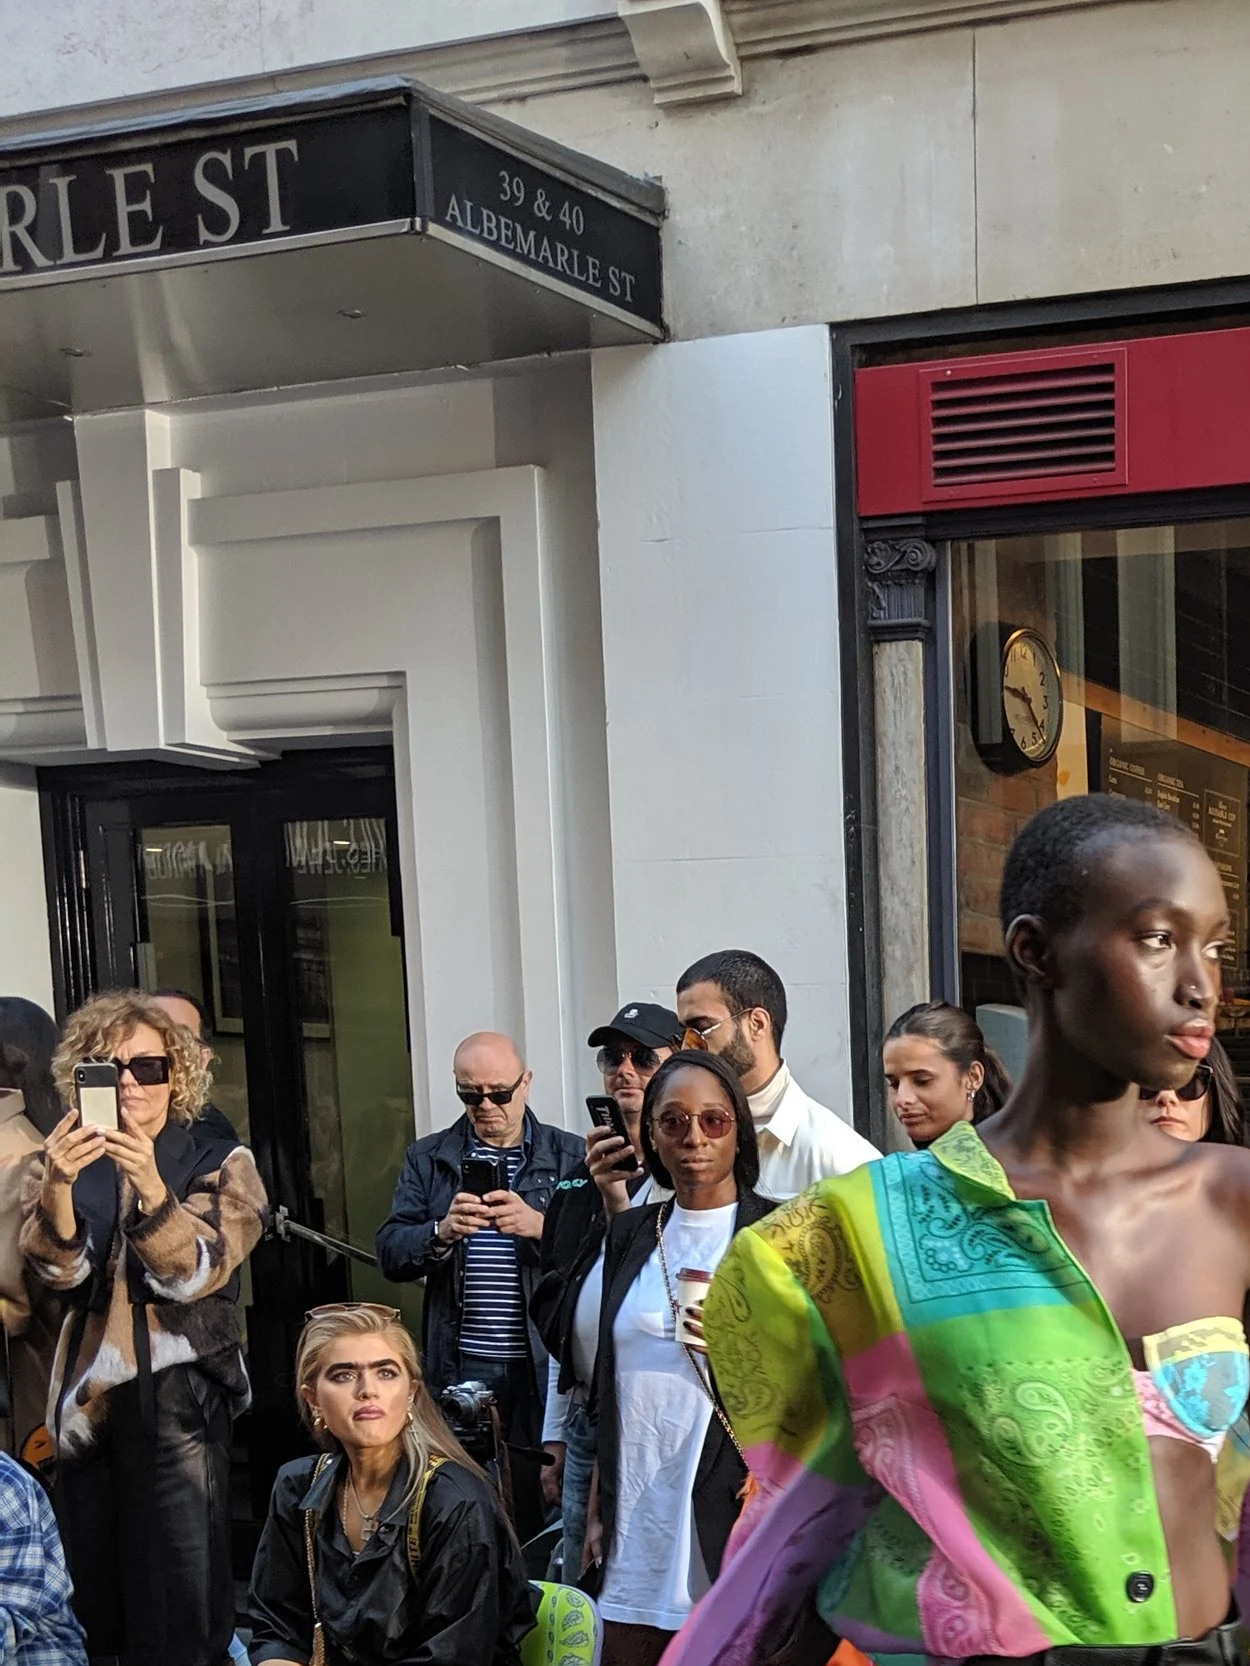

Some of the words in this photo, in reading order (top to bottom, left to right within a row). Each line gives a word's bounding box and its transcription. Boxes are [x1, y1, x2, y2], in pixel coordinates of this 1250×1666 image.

[0, 163, 163, 273] RLE
[194, 139, 299, 247] ST
[445, 193, 602, 288] ALBEMARLE
[608, 265, 636, 302] ST
[499, 170, 525, 207] 39
[533, 188, 553, 222] &
[559, 201, 584, 236] 40
